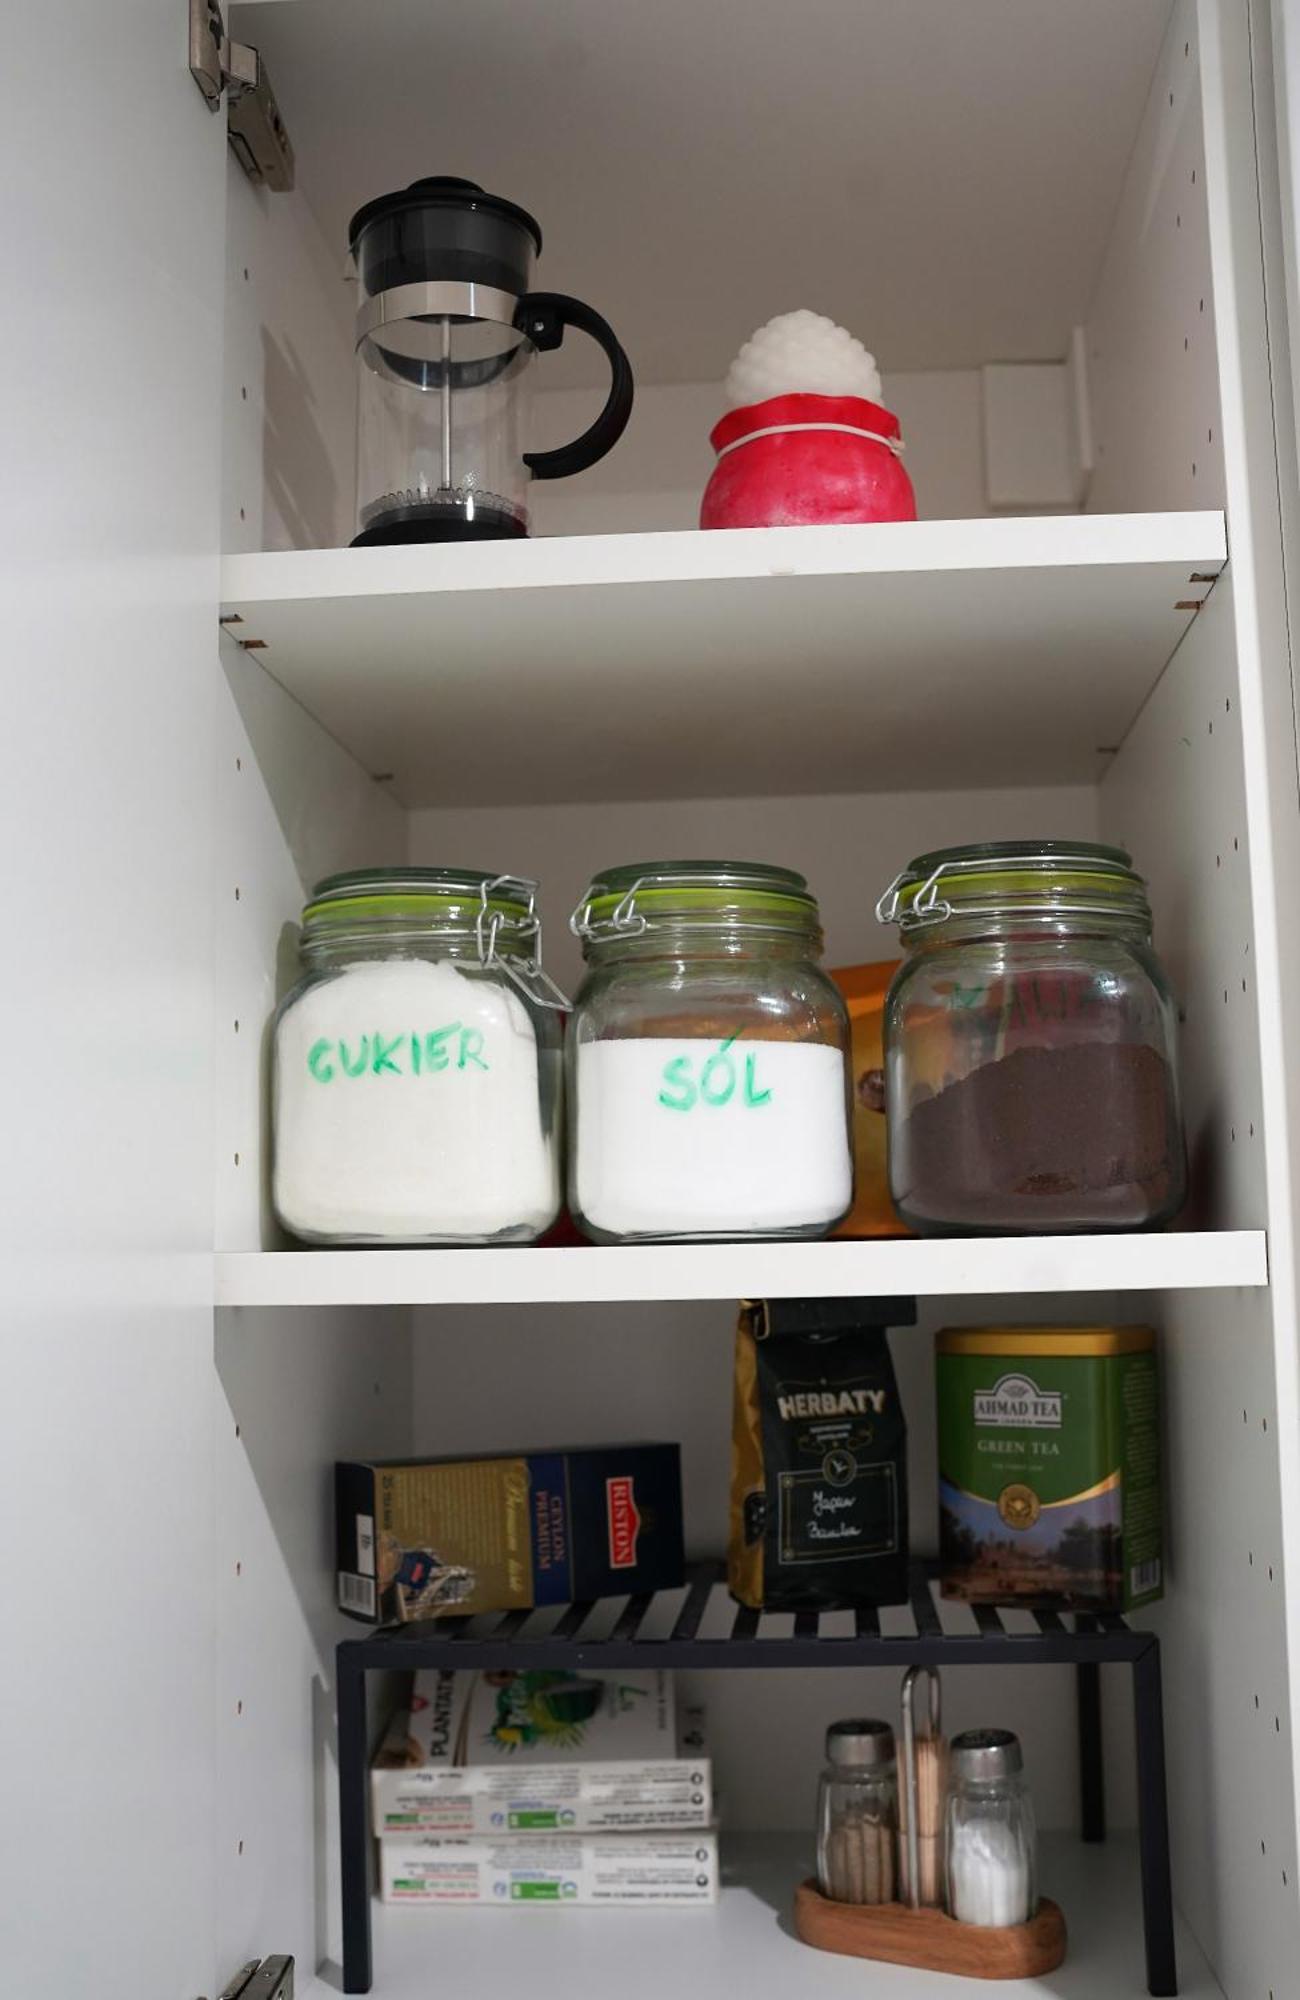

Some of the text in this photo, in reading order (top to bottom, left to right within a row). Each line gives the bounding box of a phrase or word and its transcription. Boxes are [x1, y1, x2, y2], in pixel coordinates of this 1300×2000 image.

[658, 1027, 773, 1112] SÓL
[777, 1389, 885, 1421] HERBATY
[976, 1400, 1059, 1417] AHMAD TEA
[977, 1439, 1061, 1456] GREEN TEA
[536, 1490, 550, 1570] PREMIUM
[550, 1496, 564, 1562] CEYLON
[611, 1483, 631, 1563] RISTON
